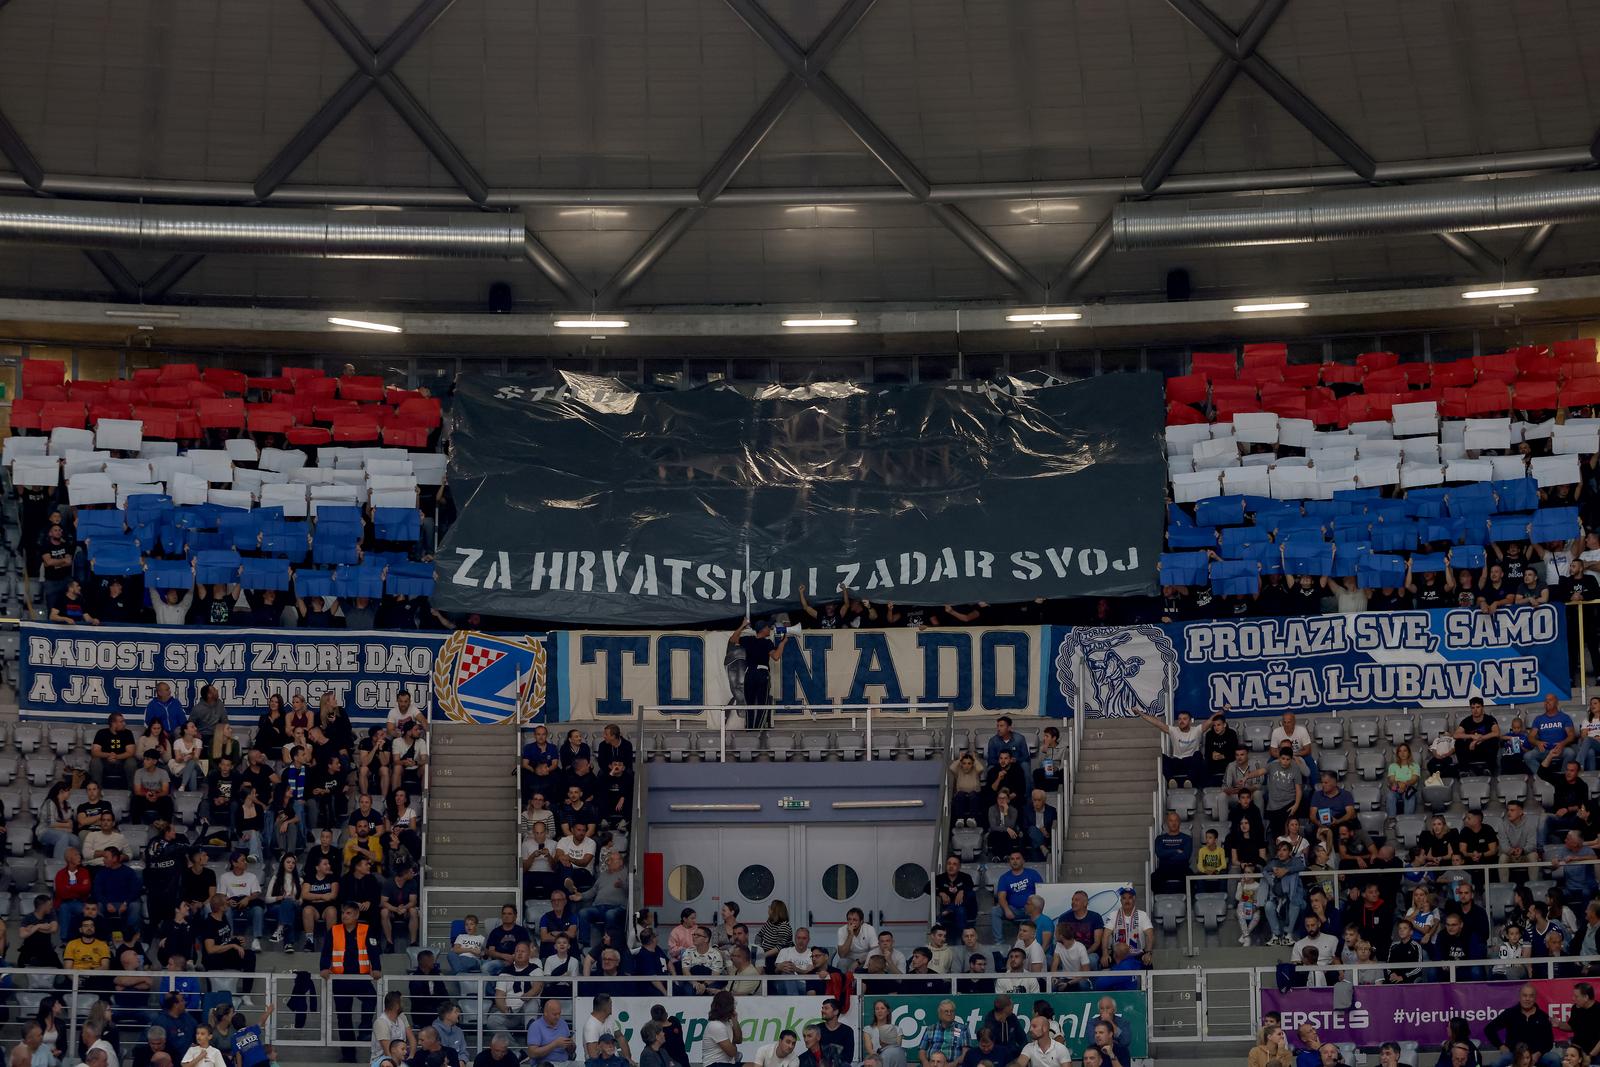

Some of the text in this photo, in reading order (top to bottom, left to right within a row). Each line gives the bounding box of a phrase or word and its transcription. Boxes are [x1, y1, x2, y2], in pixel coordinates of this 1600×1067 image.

[451, 546, 1139, 604] ZA HRVATSKU I ZADAR SVOJ
[29, 636, 433, 676] RADOST SI MI ZADRE DAO
[1186, 606, 1556, 662] PROLAZI SVE, SAMO
[29, 673, 57, 703] A
[61, 674, 109, 706] JA
[580, 631, 1031, 716] TONADO
[1211, 658, 1538, 710] NAŠA LJUBAV NE
[1540, 721, 1563, 731] ZADAR
[1280, 1010, 1345, 1031] ERSTE
